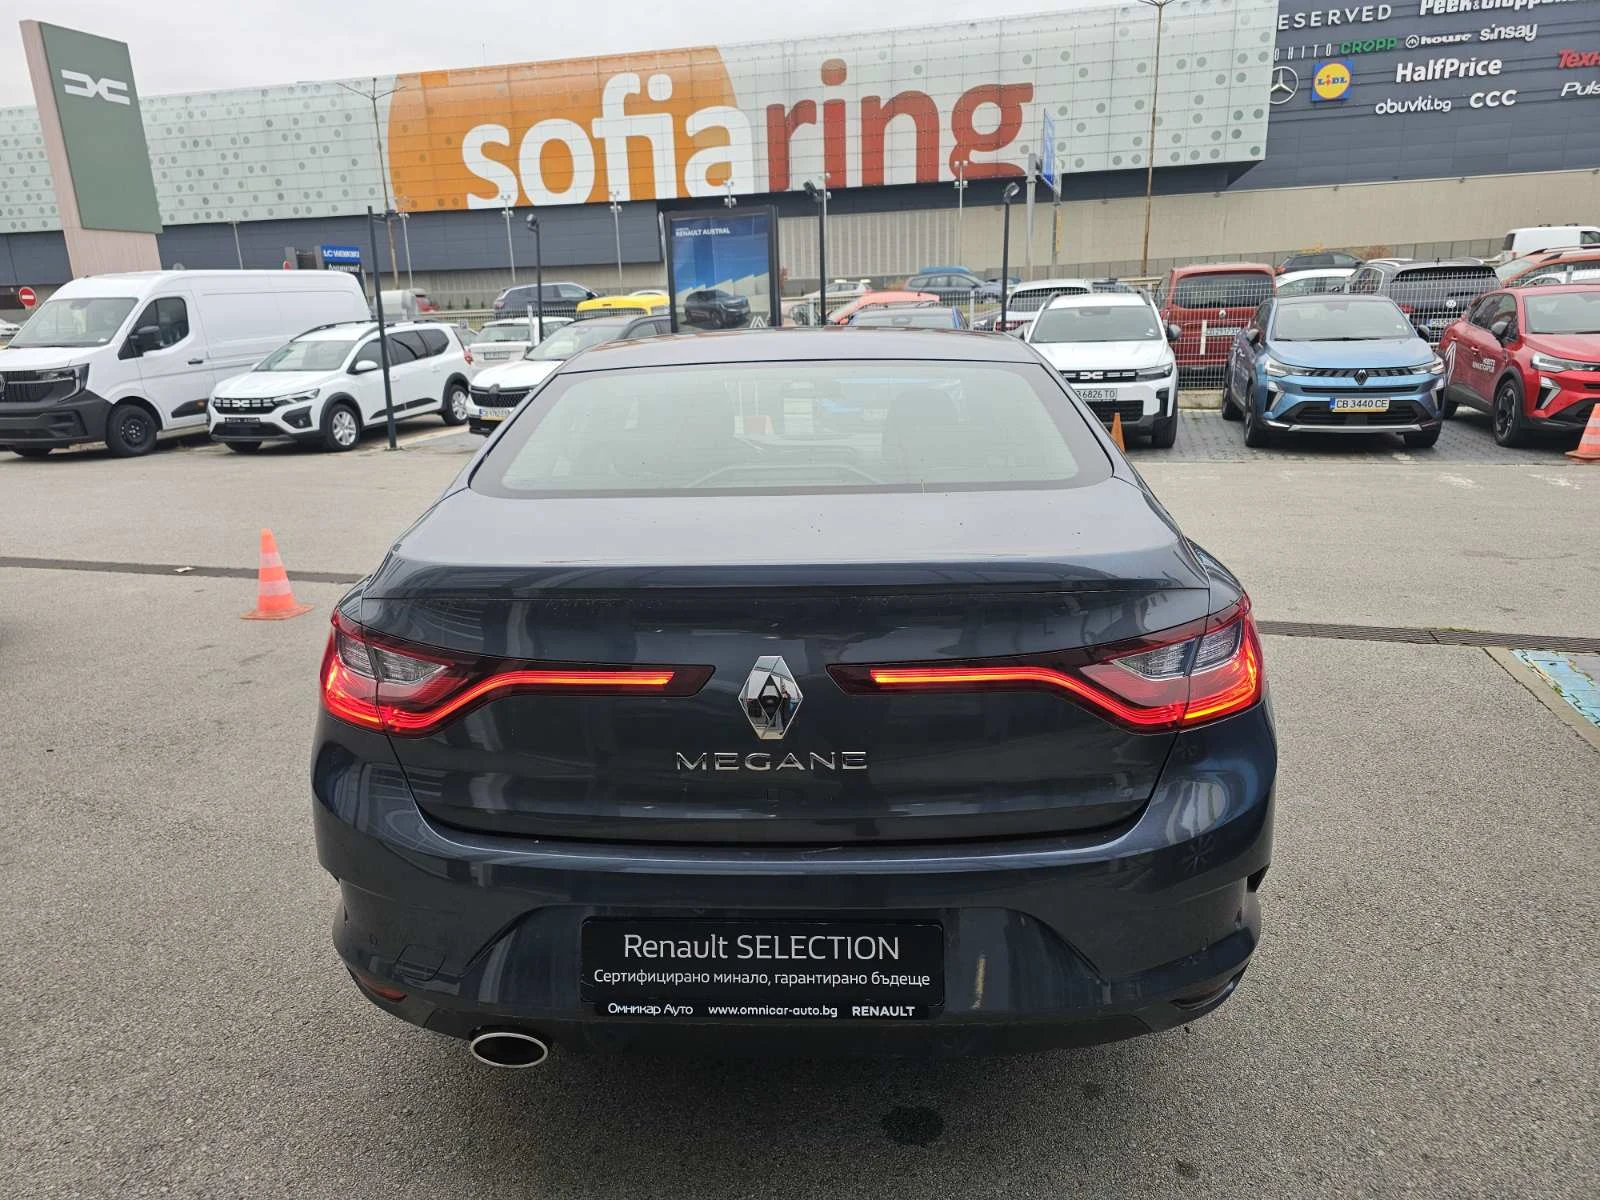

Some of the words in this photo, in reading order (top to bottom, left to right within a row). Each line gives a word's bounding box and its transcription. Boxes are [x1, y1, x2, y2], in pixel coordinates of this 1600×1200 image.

[1278, 4, 1392, 30] ESERVED
[1421, 33, 1472, 45] house
[1480, 24, 1538, 42] sinsay
[1274, 43, 1332, 61] OHITO
[1340, 37, 1398, 55] CROPP
[1396, 57, 1503, 83] HalfPrice
[1375, 95, 1452, 114] obuvki.bg
[1469, 89, 1518, 109] CCC
[1083, 390, 1103, 398] 6826
[1336, 400, 1349, 408] CB
[1350, 400, 1373, 409] 3440
[1375, 400, 1387, 408] CE
[676, 751, 868, 771] MEGANE
[624, 933, 729, 959] Renault
[736, 934, 899, 960] SELECTION
[594, 968, 710, 986] Сертифицирано
[713, 972, 771, 986] минало,
[775, 973, 868, 988] гарантирано
[871, 971, 931, 988] бъдеще
[607, 1002, 661, 1015] Омникар
[663, 1003, 694, 1016] Ауто
[708, 1005, 838, 1018] www.omnicar-auto.bg
[851, 1005, 916, 1017] RENAULT
